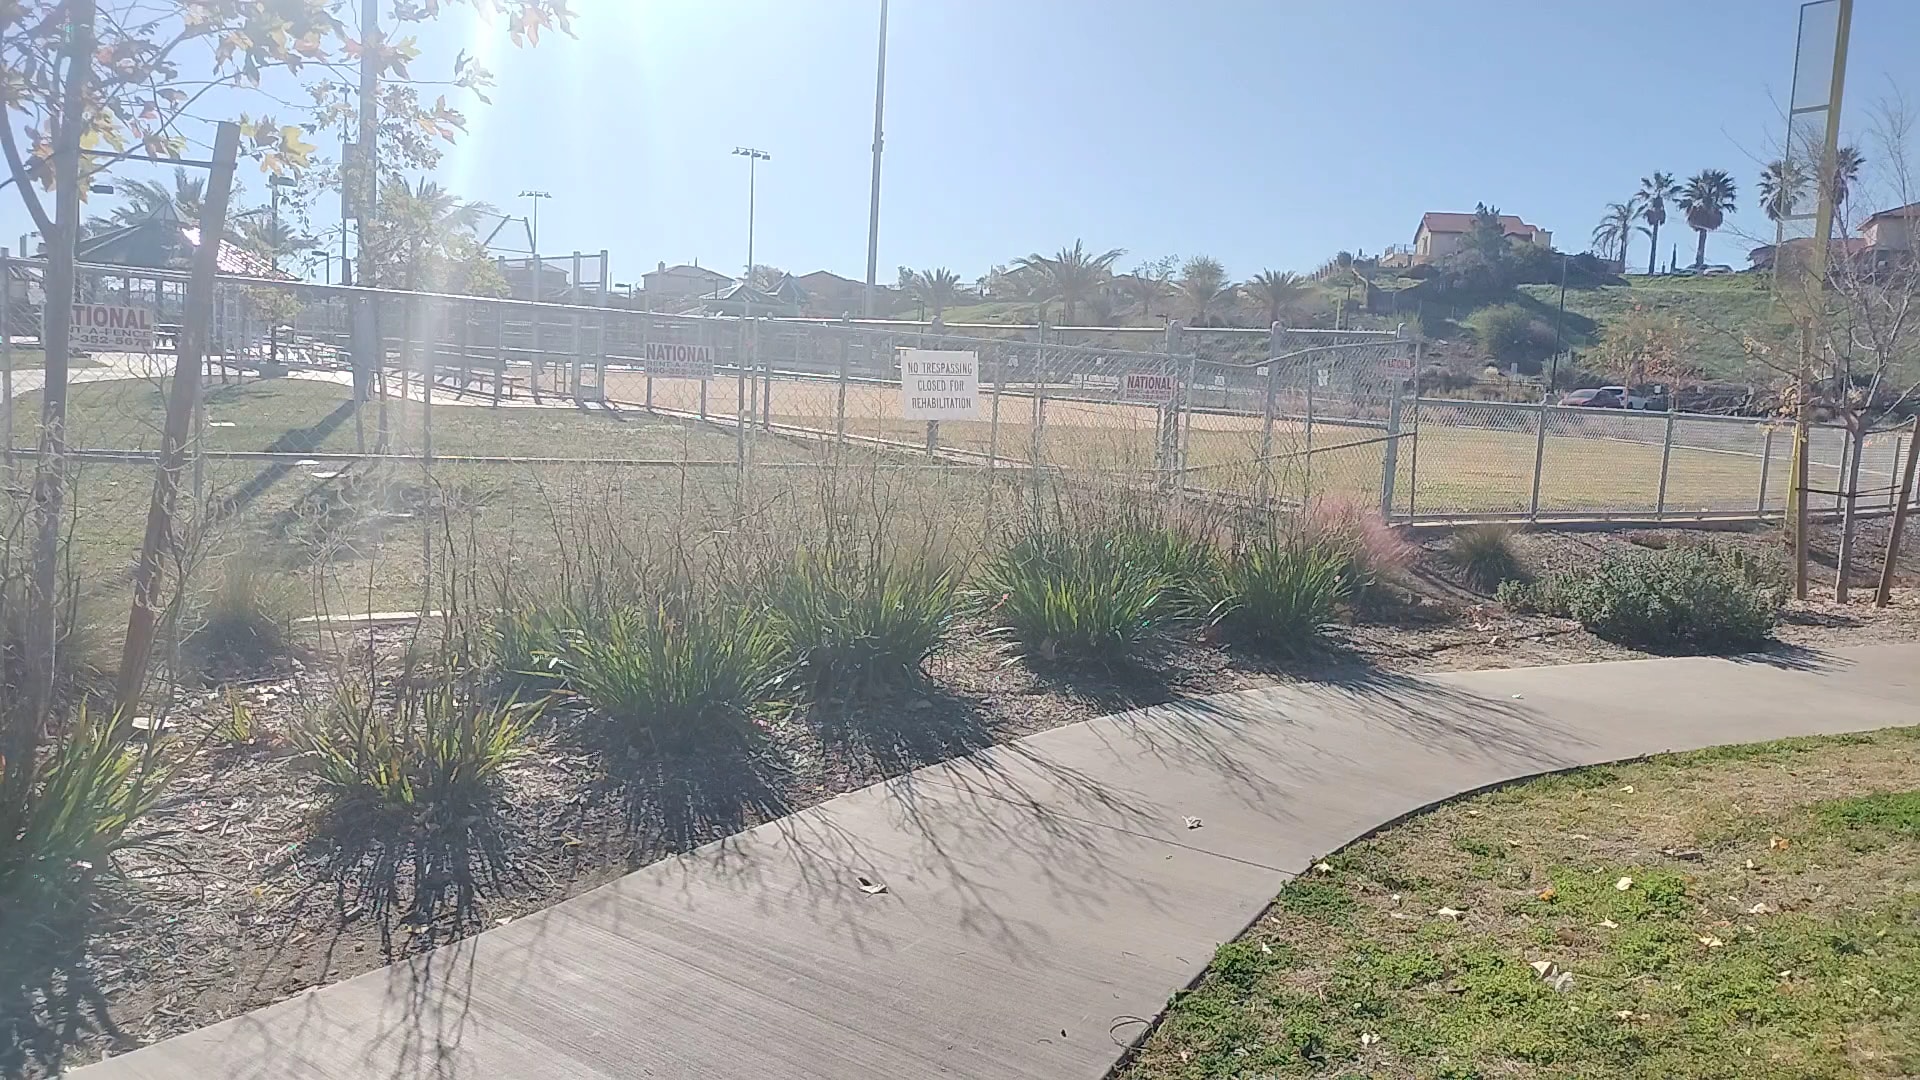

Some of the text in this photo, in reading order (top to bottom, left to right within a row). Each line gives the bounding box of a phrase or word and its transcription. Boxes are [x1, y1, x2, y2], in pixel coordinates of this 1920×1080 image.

[70, 305, 151, 330] TIONAL
[69, 334, 151, 346] -352-5675
[646, 343, 713, 362] NATIONAL
[907, 362, 973, 375] NO TRESPASSING
[917, 379, 964, 392] CLOSED FOR
[1127, 375, 1172, 390] NATIONAL
[911, 397, 972, 409] REHABILITATION
